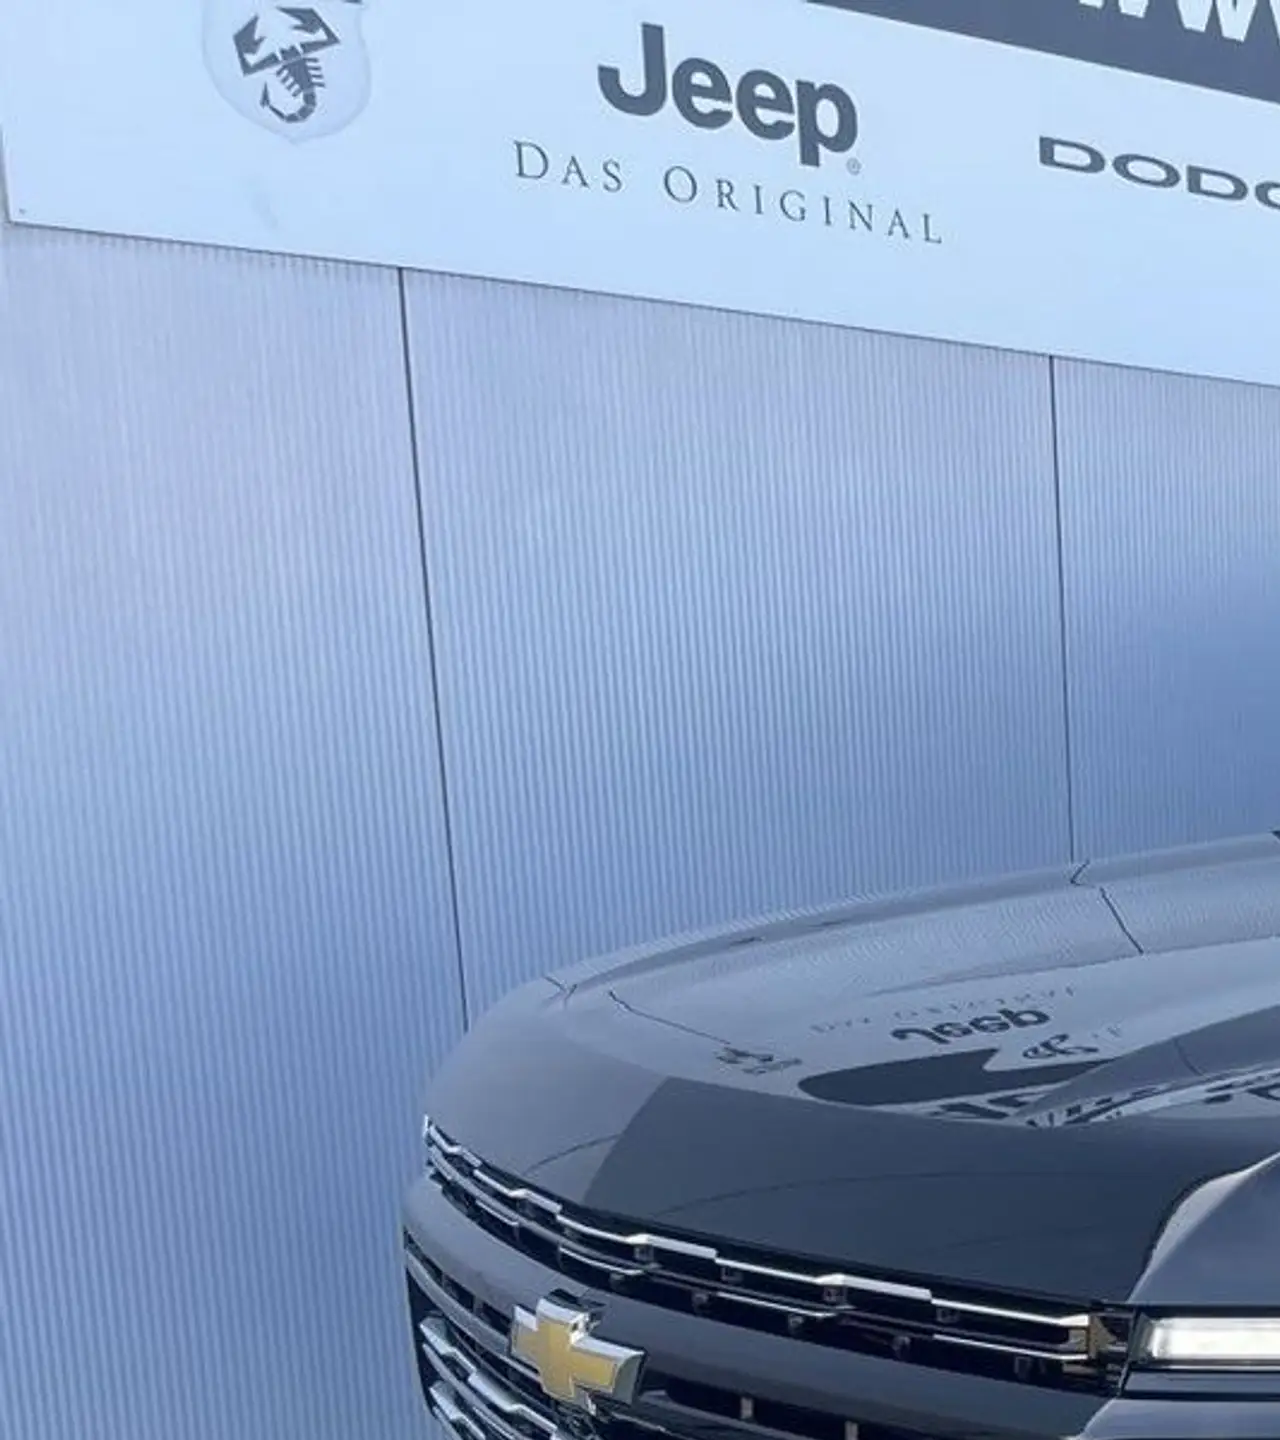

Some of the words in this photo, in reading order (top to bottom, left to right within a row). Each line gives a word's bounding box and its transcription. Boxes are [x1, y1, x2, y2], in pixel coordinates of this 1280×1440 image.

[597, 22, 859, 168] Jeep
[514, 140, 624, 193] DAS
[663, 165, 943, 244] ORIGINAL
